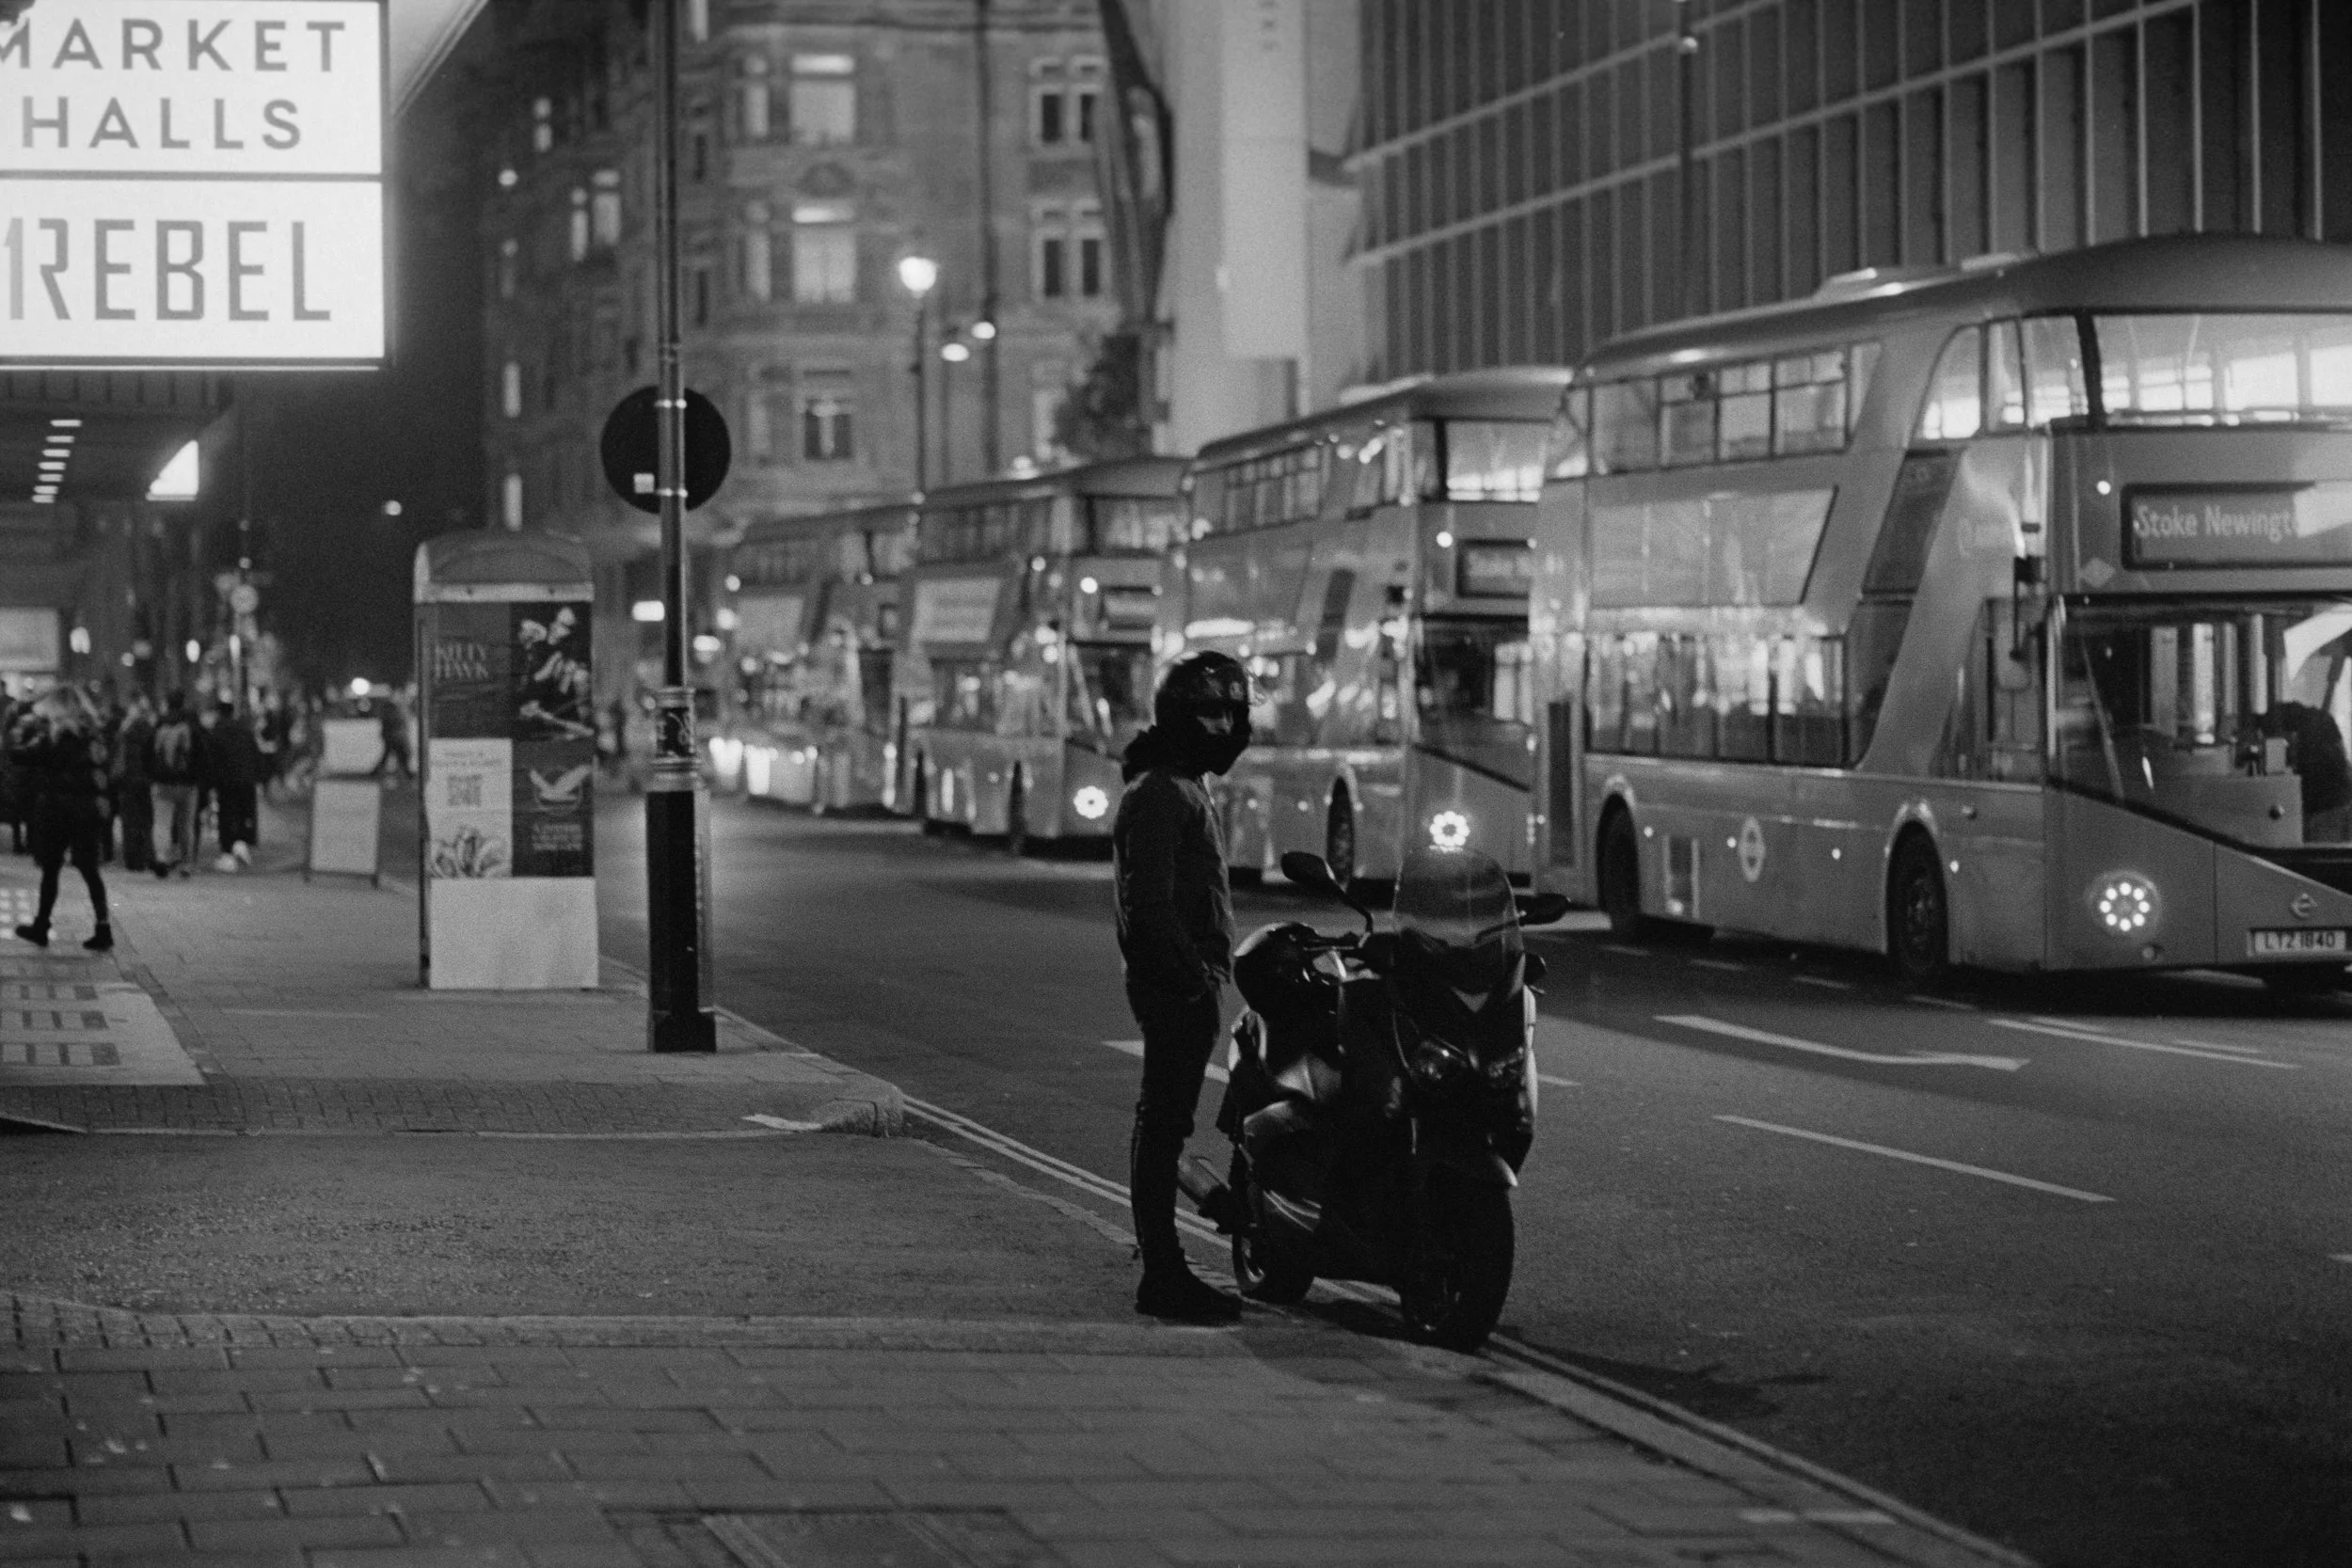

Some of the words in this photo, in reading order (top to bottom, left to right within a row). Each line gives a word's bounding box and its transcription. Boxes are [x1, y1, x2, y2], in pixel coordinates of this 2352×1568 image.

[0, 18, 345, 71] MARKET
[22, 96, 302, 150] HALLS
[2135, 504, 2199, 538] Stoke
